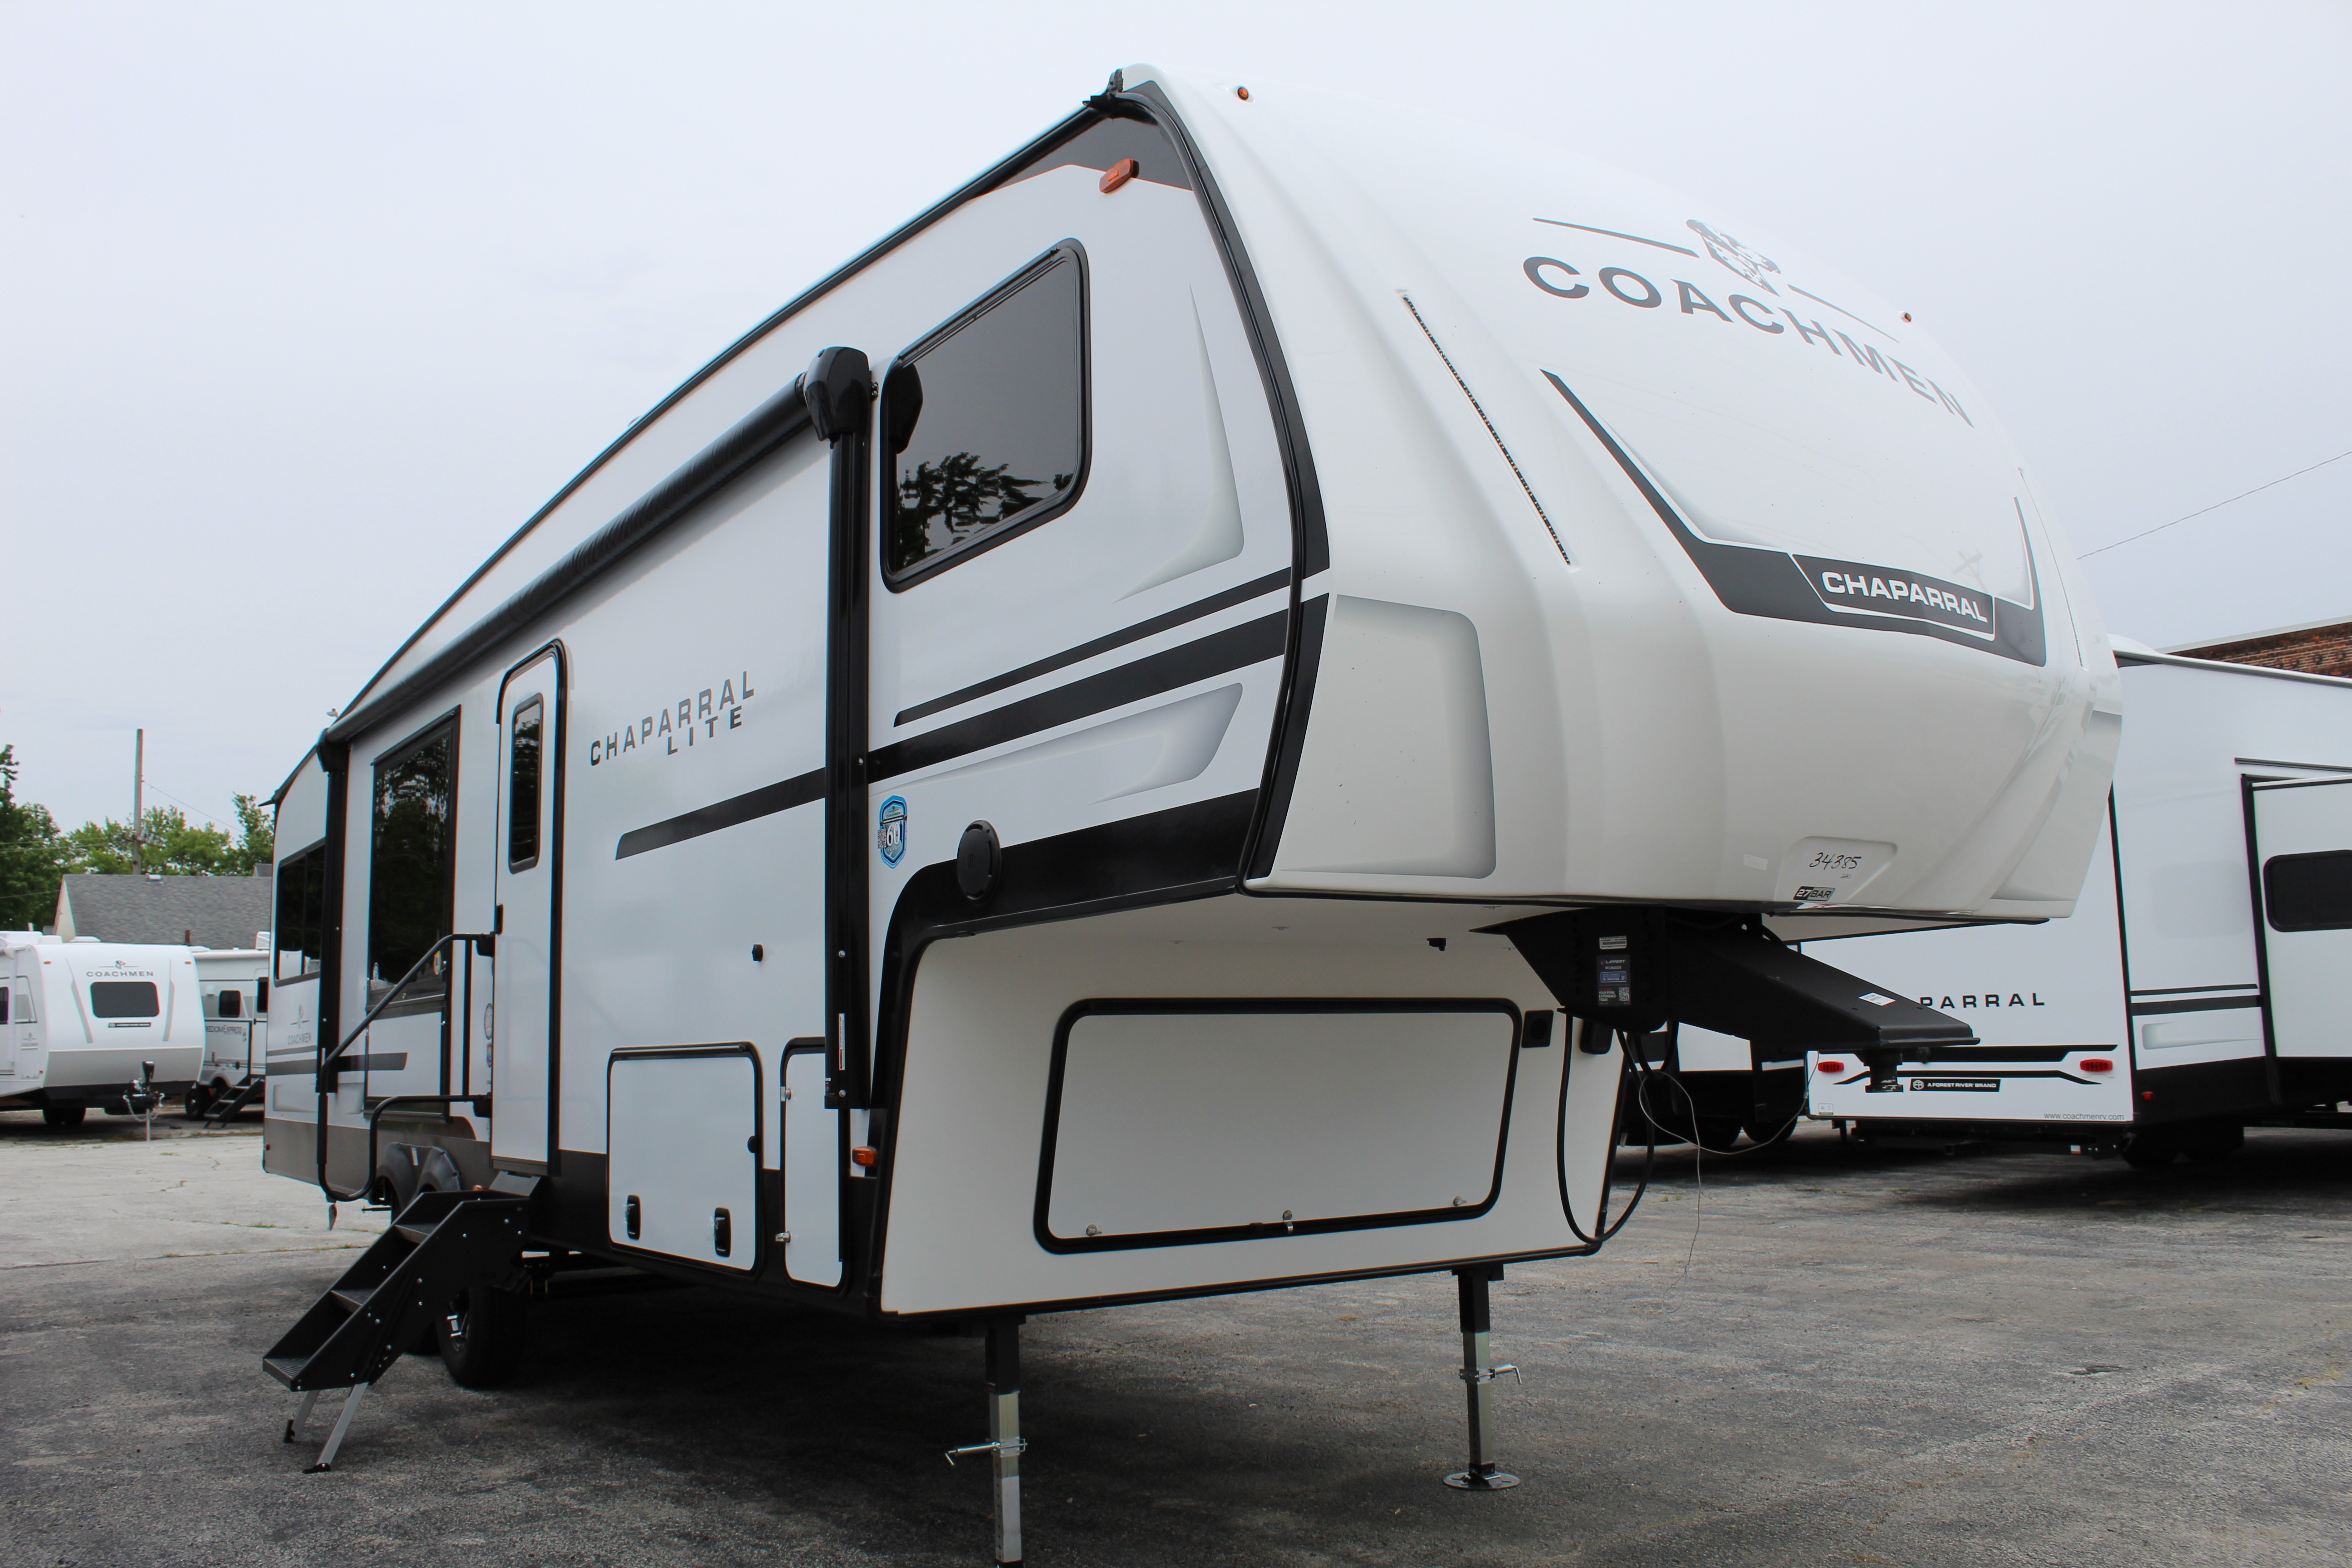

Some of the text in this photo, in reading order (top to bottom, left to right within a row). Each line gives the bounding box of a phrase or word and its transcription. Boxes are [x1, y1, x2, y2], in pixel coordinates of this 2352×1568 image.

[1523, 256, 1975, 428] COACHMEN
[1821, 571, 1988, 623] CHAPARRAL
[591, 670, 755, 766] CHAPARRAL
[667, 705, 743, 755] LITE
[887, 822, 901, 846] 60
[1809, 852, 1862, 870] 34385
[1920, 992, 2045, 1009] PARRAL
